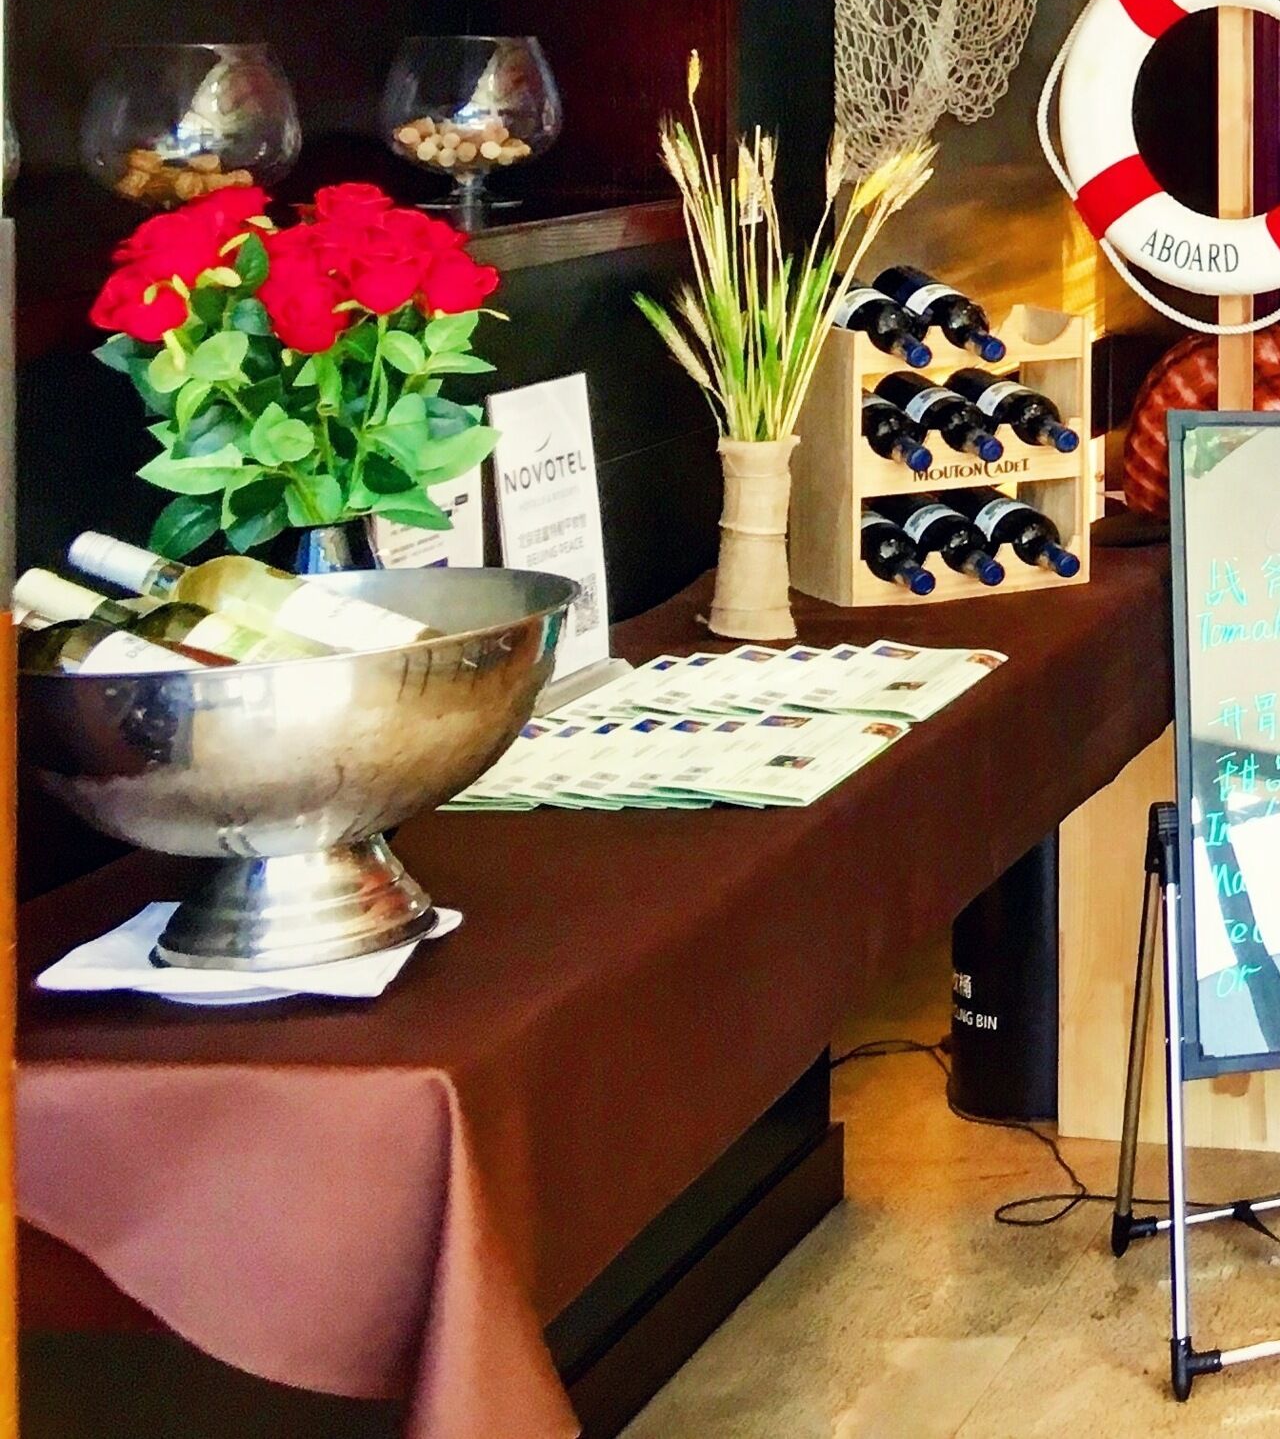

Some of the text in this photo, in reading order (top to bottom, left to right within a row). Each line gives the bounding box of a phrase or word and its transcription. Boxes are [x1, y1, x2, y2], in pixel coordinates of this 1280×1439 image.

[1140, 229, 1240, 273] ABOARD
[504, 450, 588, 494] NOVOTEL
[913, 458, 1030, 482] MOUTON CADET
[1216, 965, 1263, 998] or
[975, 1013, 998, 1030] BIN
